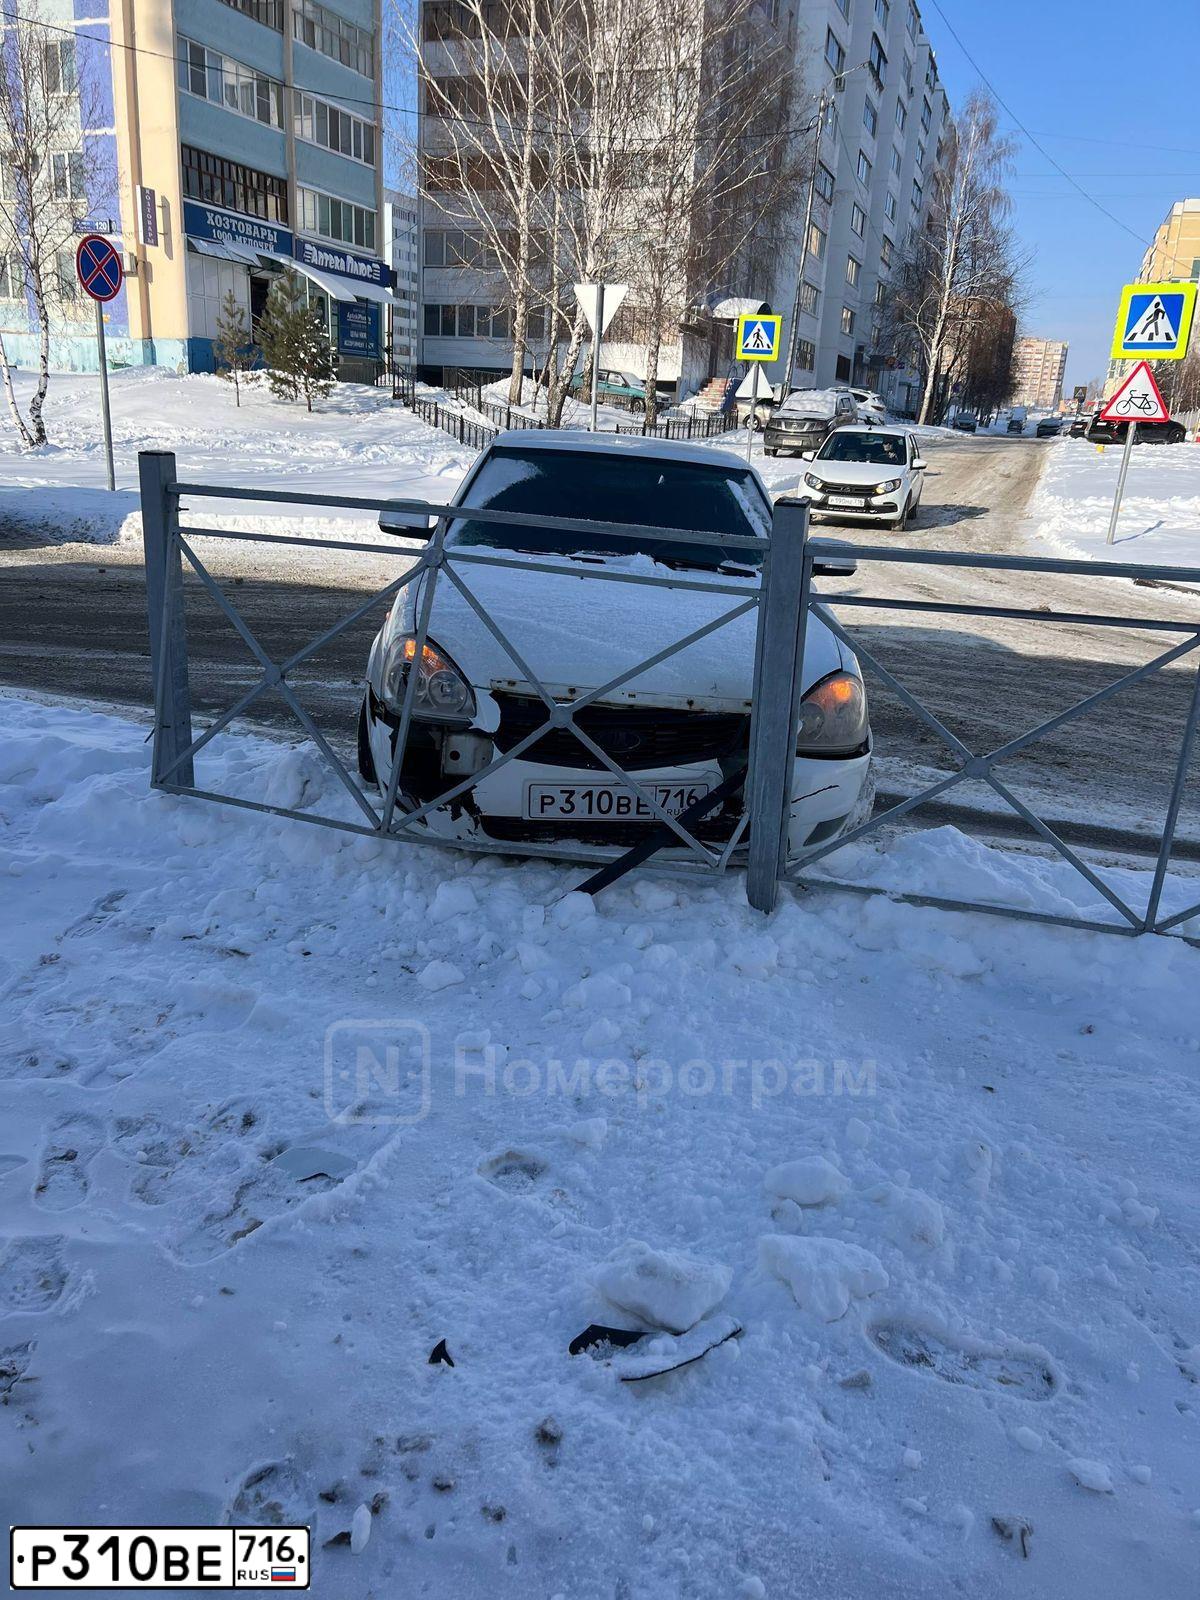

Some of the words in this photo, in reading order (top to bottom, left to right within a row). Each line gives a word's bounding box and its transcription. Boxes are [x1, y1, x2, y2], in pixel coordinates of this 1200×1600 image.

[206, 211, 278, 243] ХОЗТОВАРЫ
[212, 228, 232, 241] 1000
[658, 788, 699, 809] 716
